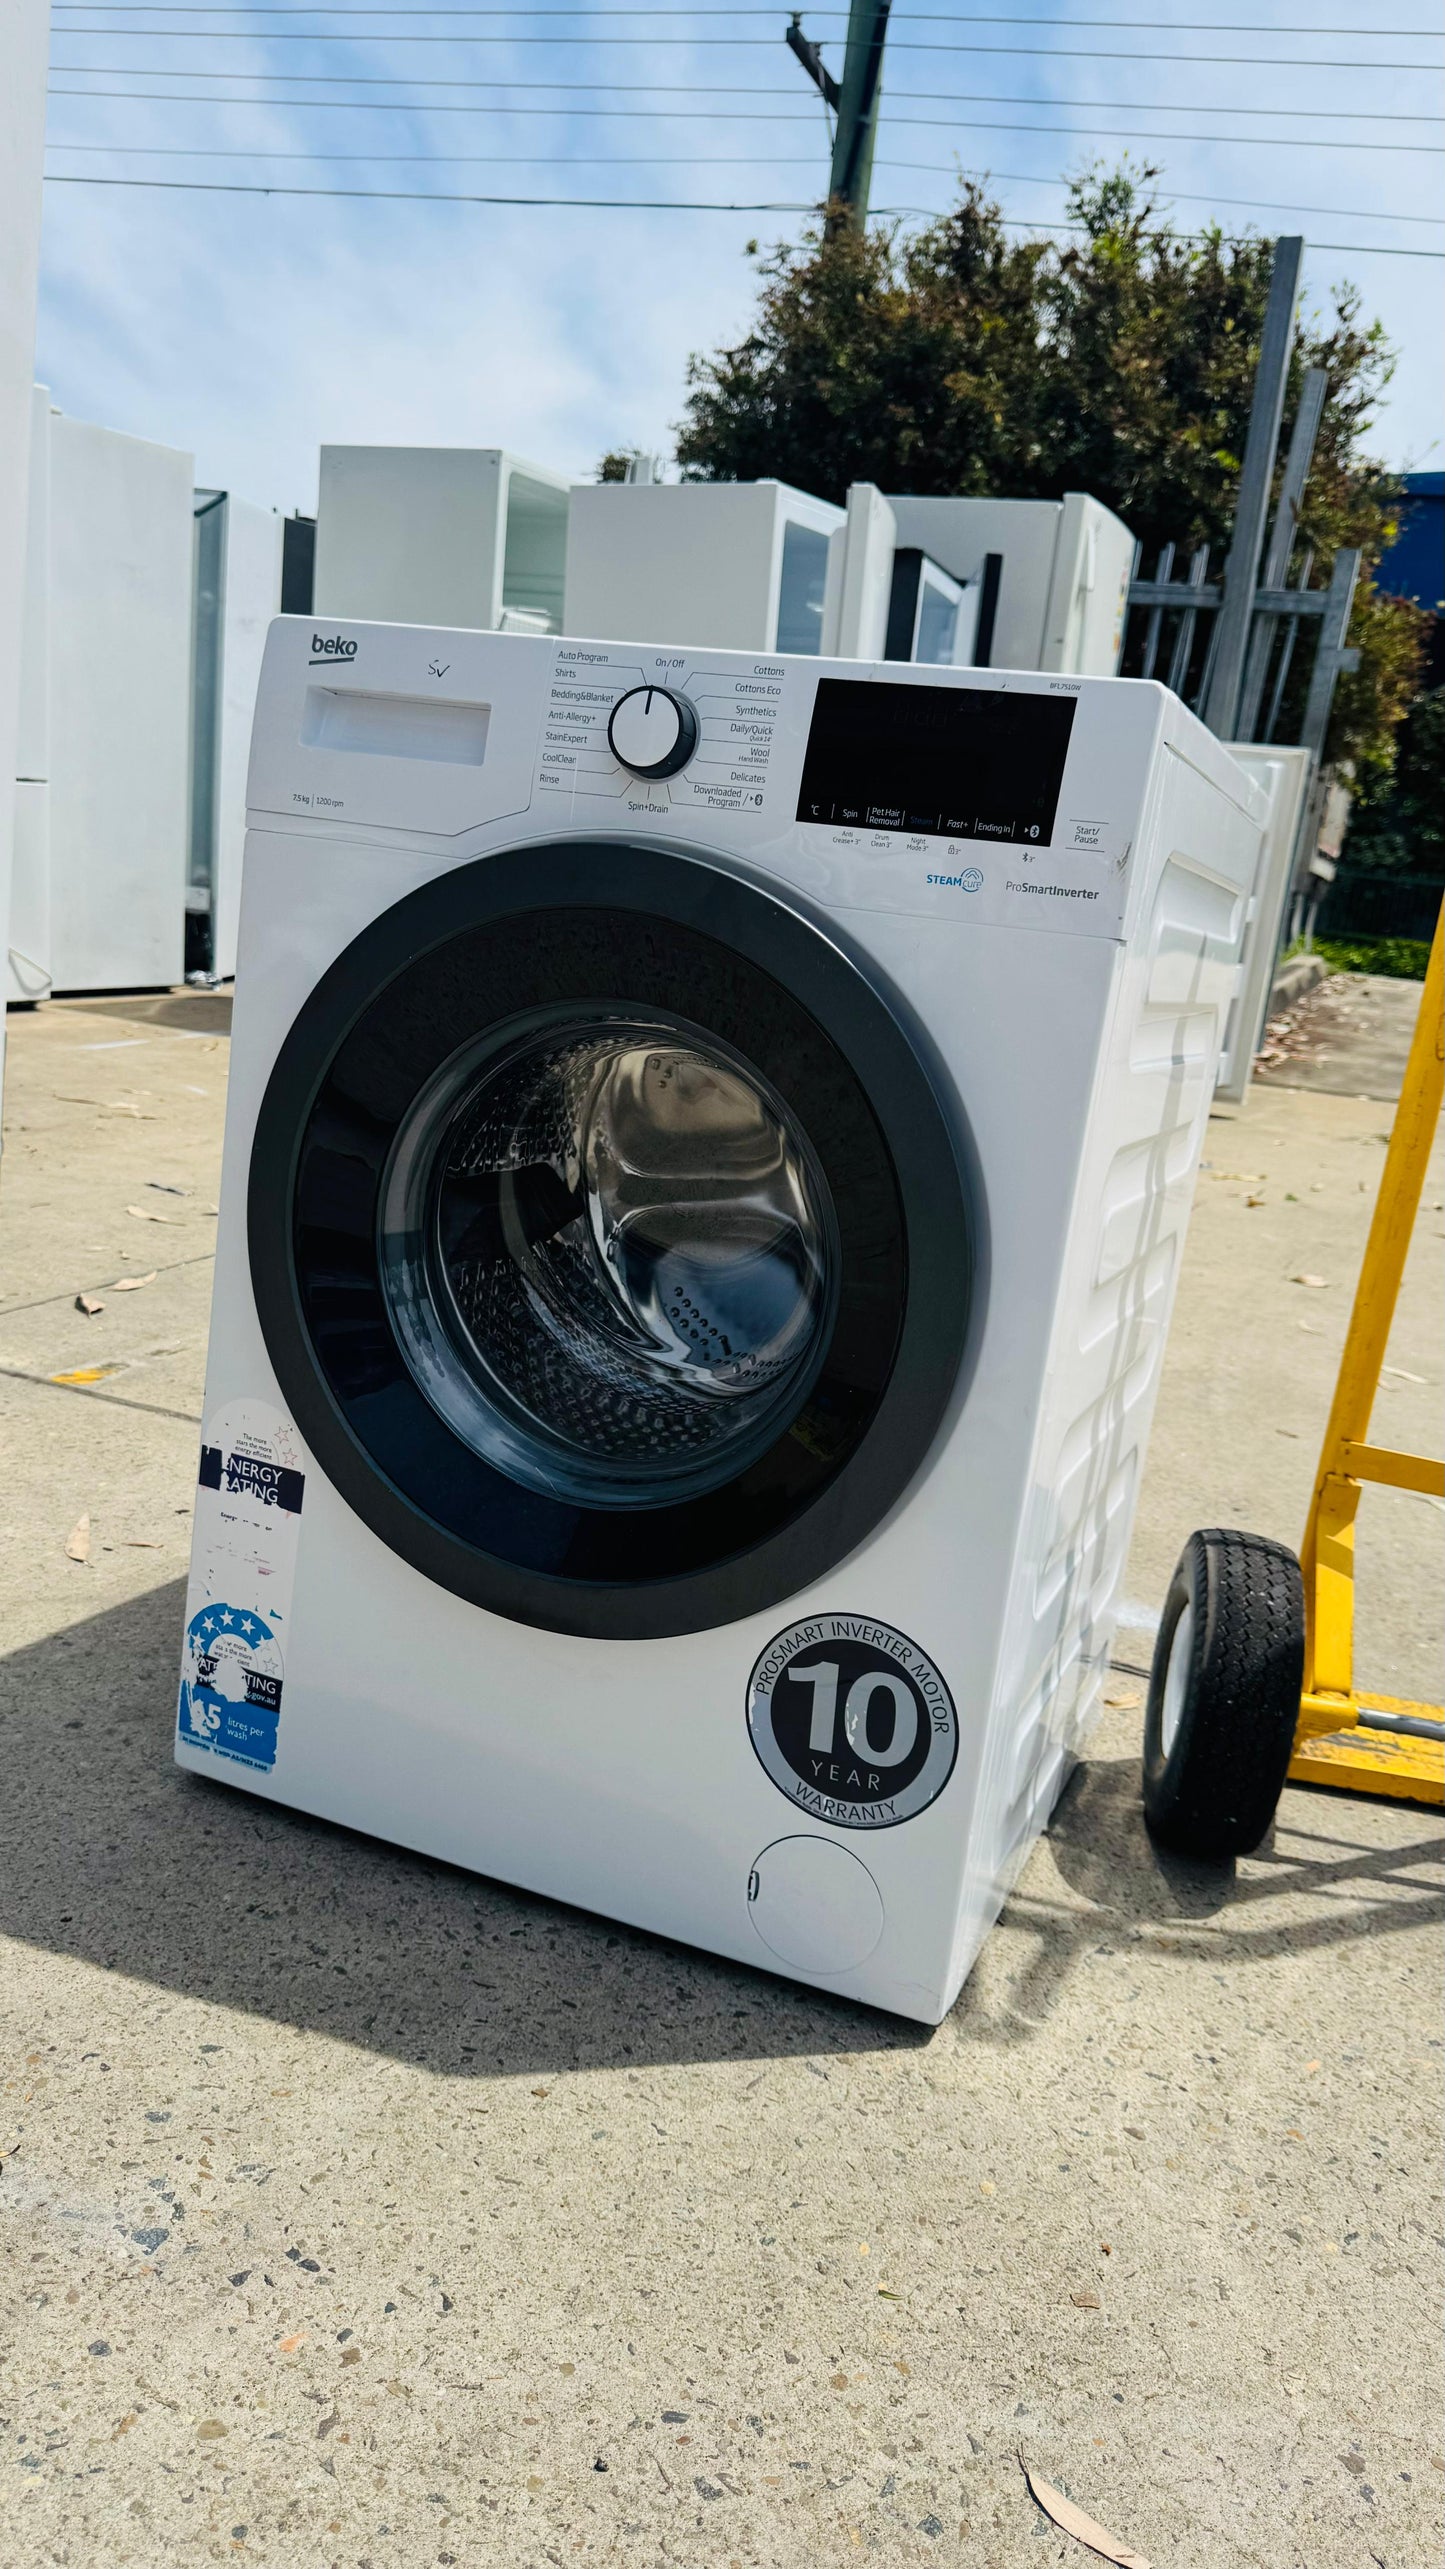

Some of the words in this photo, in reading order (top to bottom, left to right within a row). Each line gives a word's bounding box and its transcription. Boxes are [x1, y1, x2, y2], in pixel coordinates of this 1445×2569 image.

[312, 634, 358, 656] beko
[558, 650, 577, 660] Auto
[577, 651, 609, 663] Program
[555, 668, 577, 678] Shirts
[754, 665, 785, 676] Cottons
[735, 683, 766, 693] Cottons
[767, 686, 782, 695] Eco
[551, 689, 614, 703] Bedding&Blanket
[736, 705, 777, 717] Synthetics
[548, 711, 596, 724] Anti-Allergy+
[730, 723, 774, 736] Daily/Quick
[545, 731, 588, 744] StainExpert
[750, 747, 770, 757] Wool
[539, 773, 560, 784] Rinse
[730, 771, 766, 783] Delicates
[693, 784, 742, 797] Downloaded
[316, 796, 332, 806] 1200
[331, 800, 345, 808] rpm
[627, 801, 669, 813] Spin+Drain
[707, 795, 741, 808] Program
[842, 808, 858, 819] Spin
[871, 807, 884, 816] Pet
[884, 808, 901, 817] Hair
[869, 816, 901, 827] Removal
[946, 819, 969, 829] Fast+
[841, 830, 854, 838] Anti
[977, 822, 1003, 835] Ending
[1075, 825, 1100, 836] Start/
[874, 833, 890, 842] Drum
[910, 836, 926, 845] Night
[1074, 834, 1099, 845] Pause
[870, 840, 886, 849] Clean
[906, 843, 922, 852] Mode
[926, 873, 962, 887] STEAM
[1005, 880, 1100, 900] ProSmartInverter
[243, 1432, 253, 1440] The
[253, 1436, 267, 1445] more
[235, 1446, 252, 1456] energy
[236, 1439, 249, 1447] stars
[248, 1442, 257, 1450] the
[258, 1446, 273, 1454] more
[755, 1622, 825, 1695] PROSMART
[831, 1621, 913, 1664] INVERTER
[911, 1663, 950, 1734] MOTOR
[787, 1660, 918, 1768] 10
[227, 1716, 248, 1732] litres
[249, 1725, 265, 1738] per
[227, 1727, 248, 1742] wash
[811, 1759, 881, 1791] YEAR
[795, 1781, 897, 1822] WARRANTY
